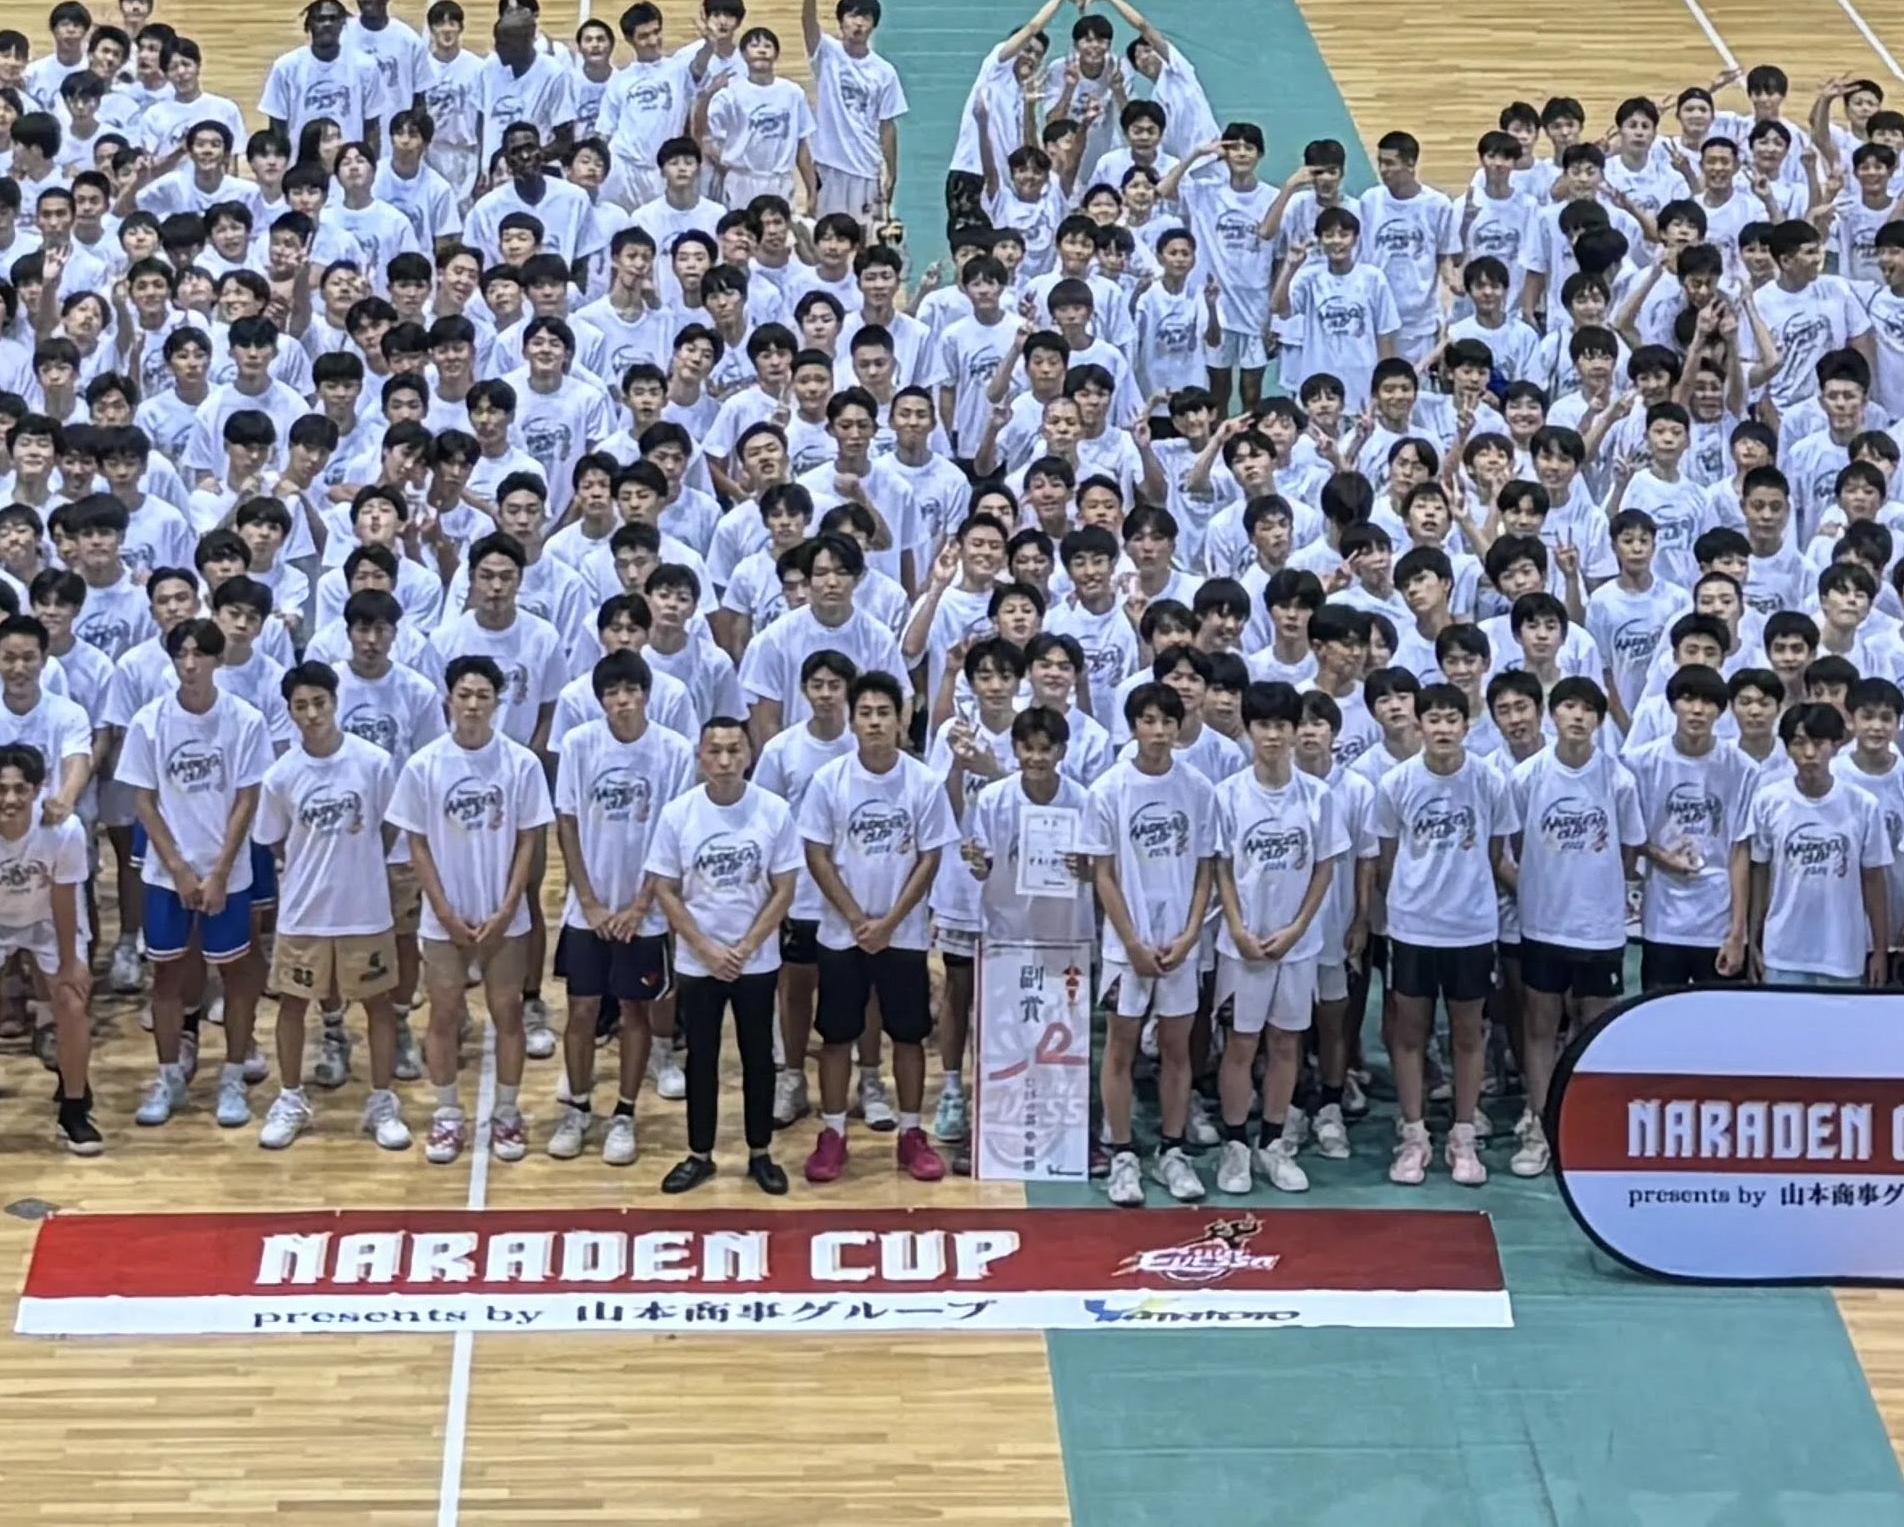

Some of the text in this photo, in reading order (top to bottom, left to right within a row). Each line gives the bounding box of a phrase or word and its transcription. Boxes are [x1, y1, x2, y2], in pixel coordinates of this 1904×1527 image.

[1019, 965, 1044, 1023] 副賞
[1627, 1099, 1873, 1161] NARADEN
[1628, 1185, 1766, 1208] presents by
[255, 1229, 1021, 1285] NARADEN CUP
[253, 1305, 544, 1327] presents by
[577, 1299, 999, 1322] 山本商事グループ
